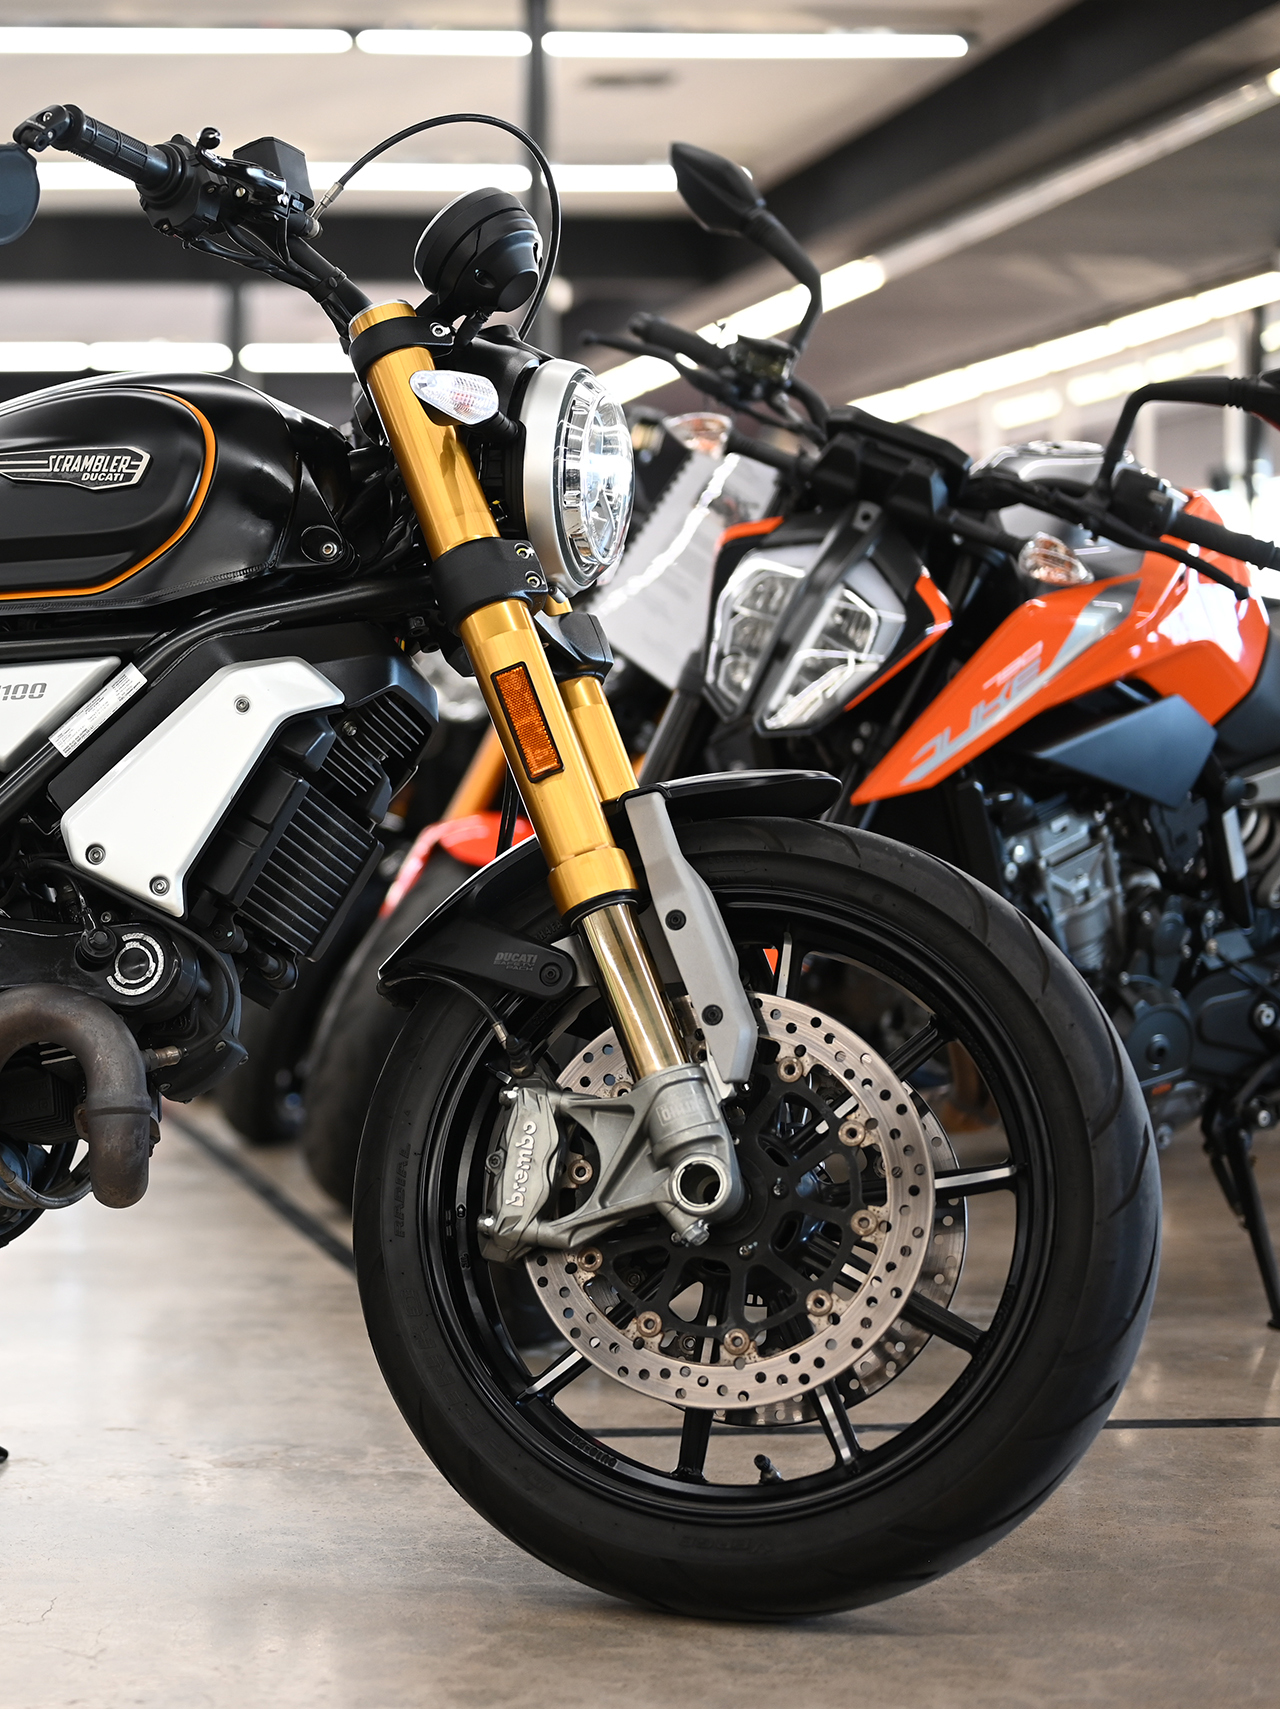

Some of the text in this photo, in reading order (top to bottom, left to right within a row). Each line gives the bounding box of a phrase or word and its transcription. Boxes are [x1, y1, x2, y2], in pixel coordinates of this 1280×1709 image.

[49, 455, 131, 473] SCRAMBLER
[81, 472, 124, 482] DUCATI
[495, 952, 538, 963] DUCATI
[506, 1120, 537, 1207] brembo
[394, 1143, 411, 1238] RADIAL
